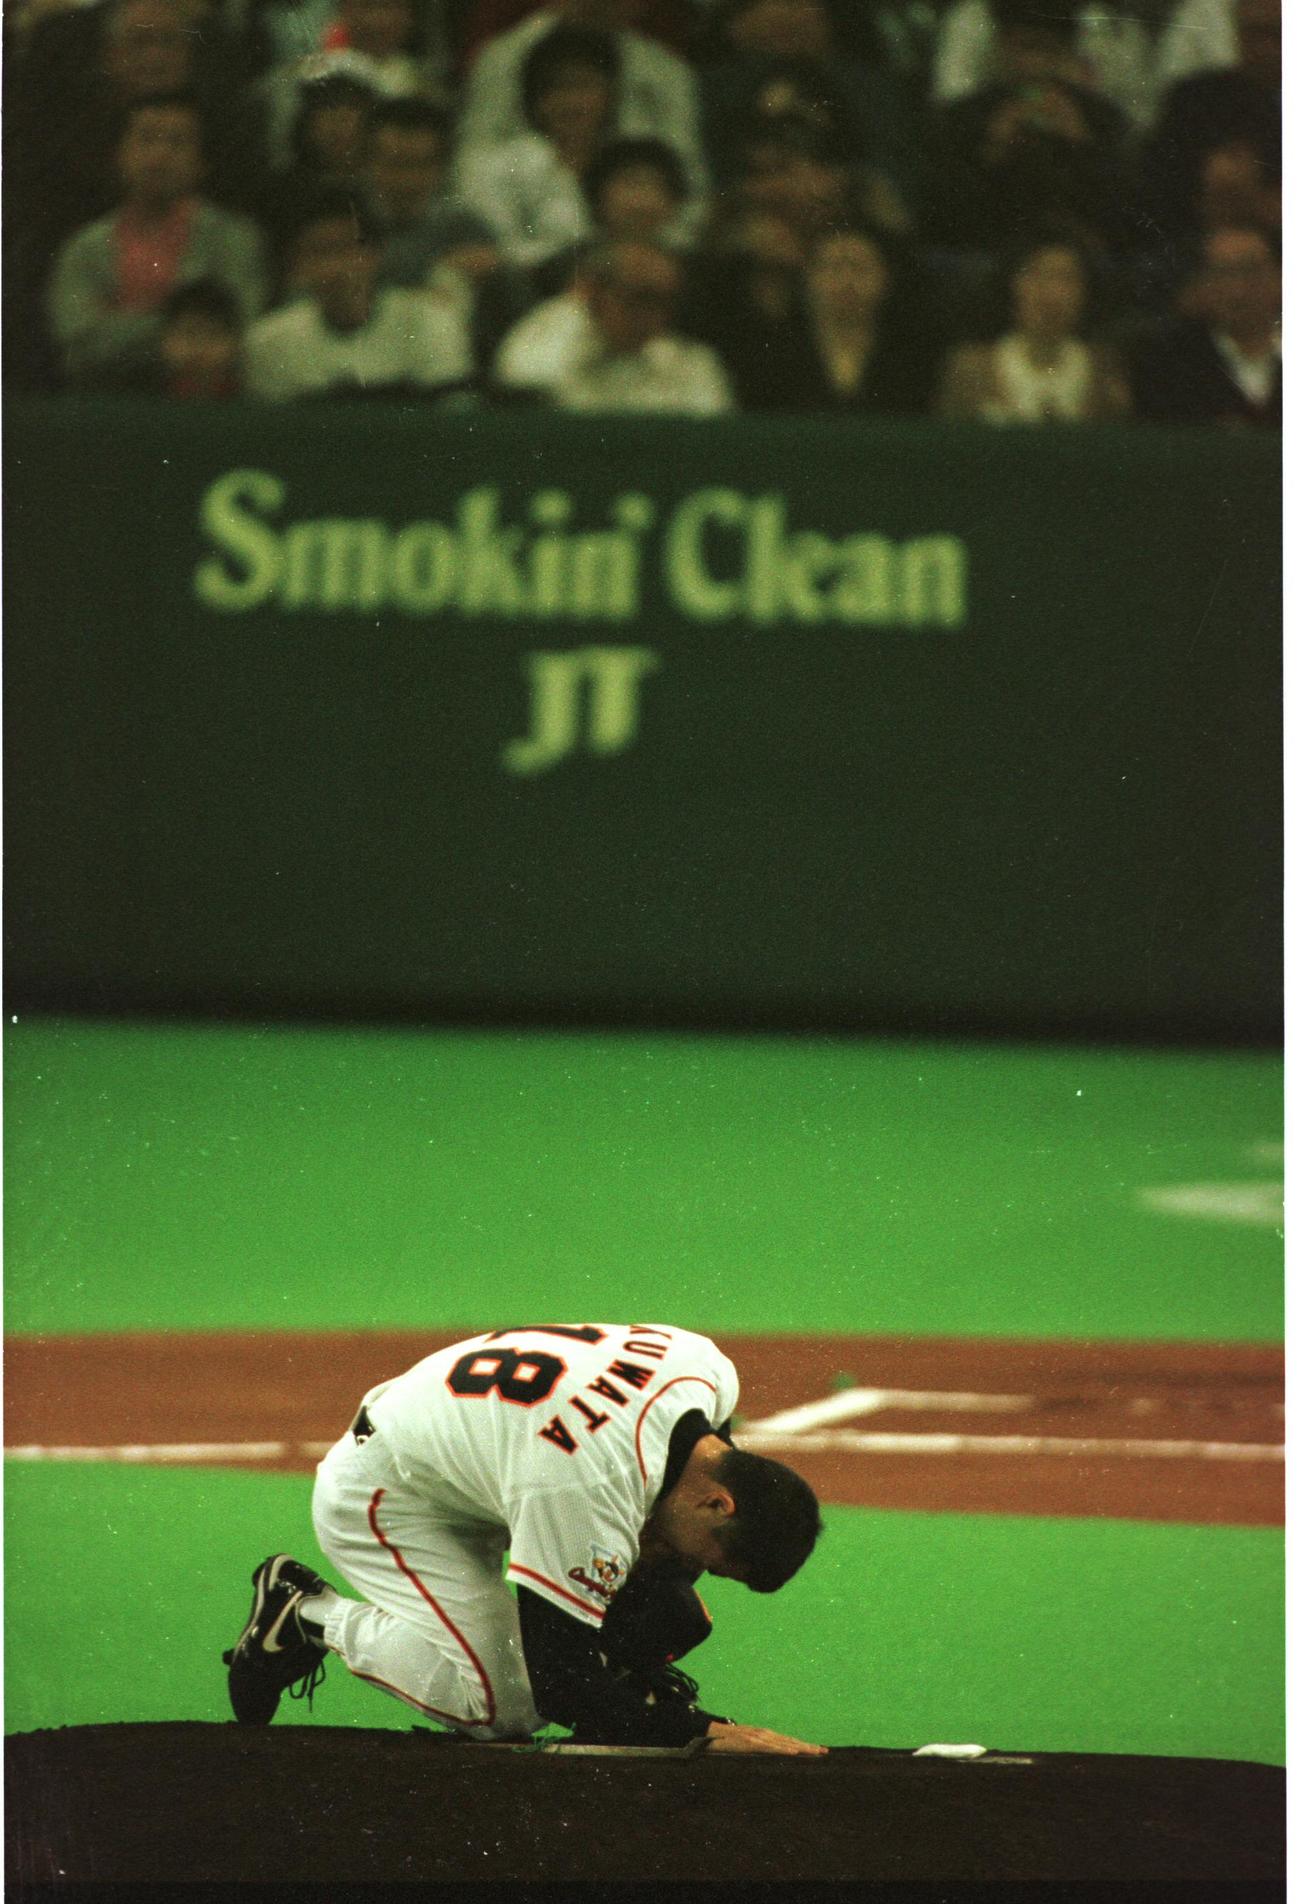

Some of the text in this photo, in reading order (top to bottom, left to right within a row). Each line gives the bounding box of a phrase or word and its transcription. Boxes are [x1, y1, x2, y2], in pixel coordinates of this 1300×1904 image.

[666, 489, 968, 627] Clean
[504, 648, 659, 774] JT
[446, 1324, 608, 1408] 18
